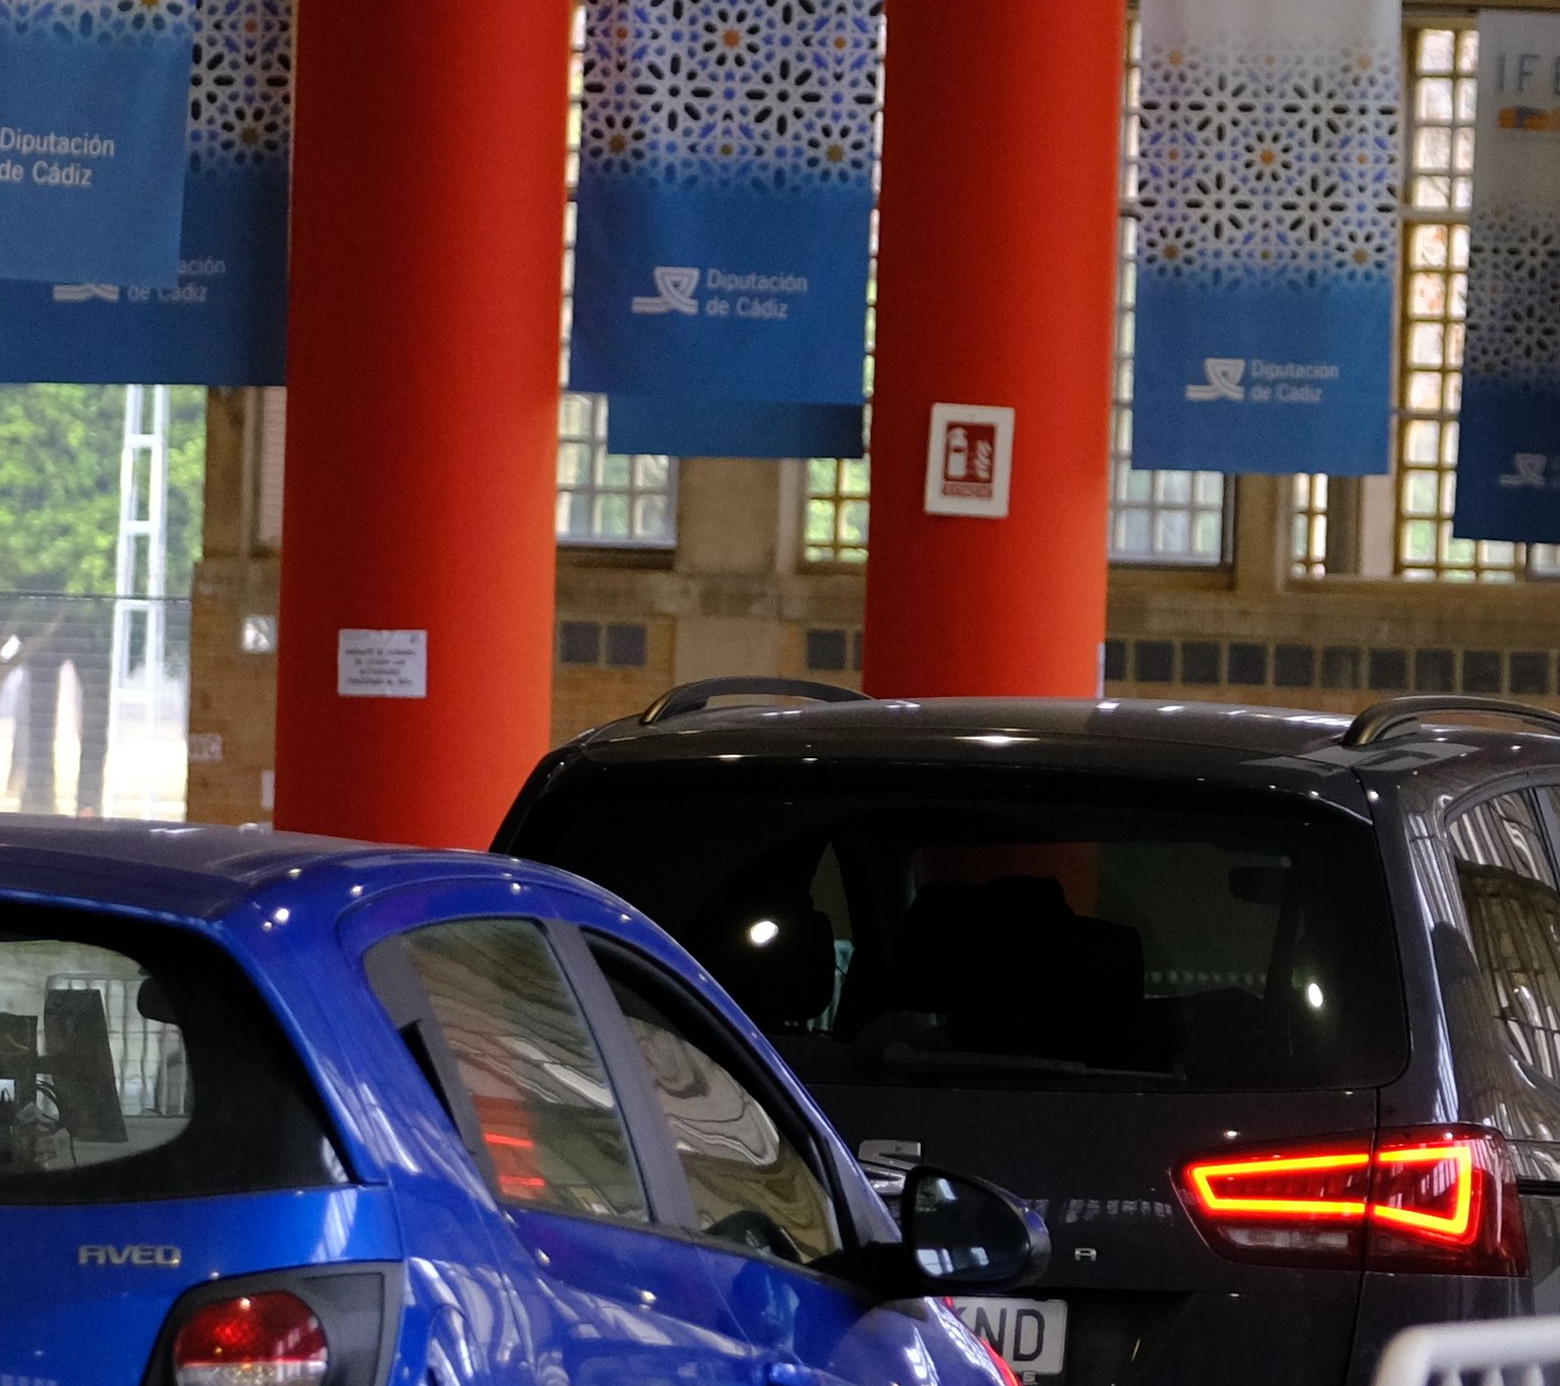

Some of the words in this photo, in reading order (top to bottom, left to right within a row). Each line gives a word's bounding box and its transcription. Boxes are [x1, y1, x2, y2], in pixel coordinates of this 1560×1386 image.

[0, 126, 115, 158] Diputación
[32, 159, 92, 186] Cádiz
[177, 255, 227, 276] ación
[707, 268, 808, 294] Diputación
[706, 296, 730, 315] de
[79, 1244, 181, 1266] AVEO
[959, 1306, 1045, 1362] ND
